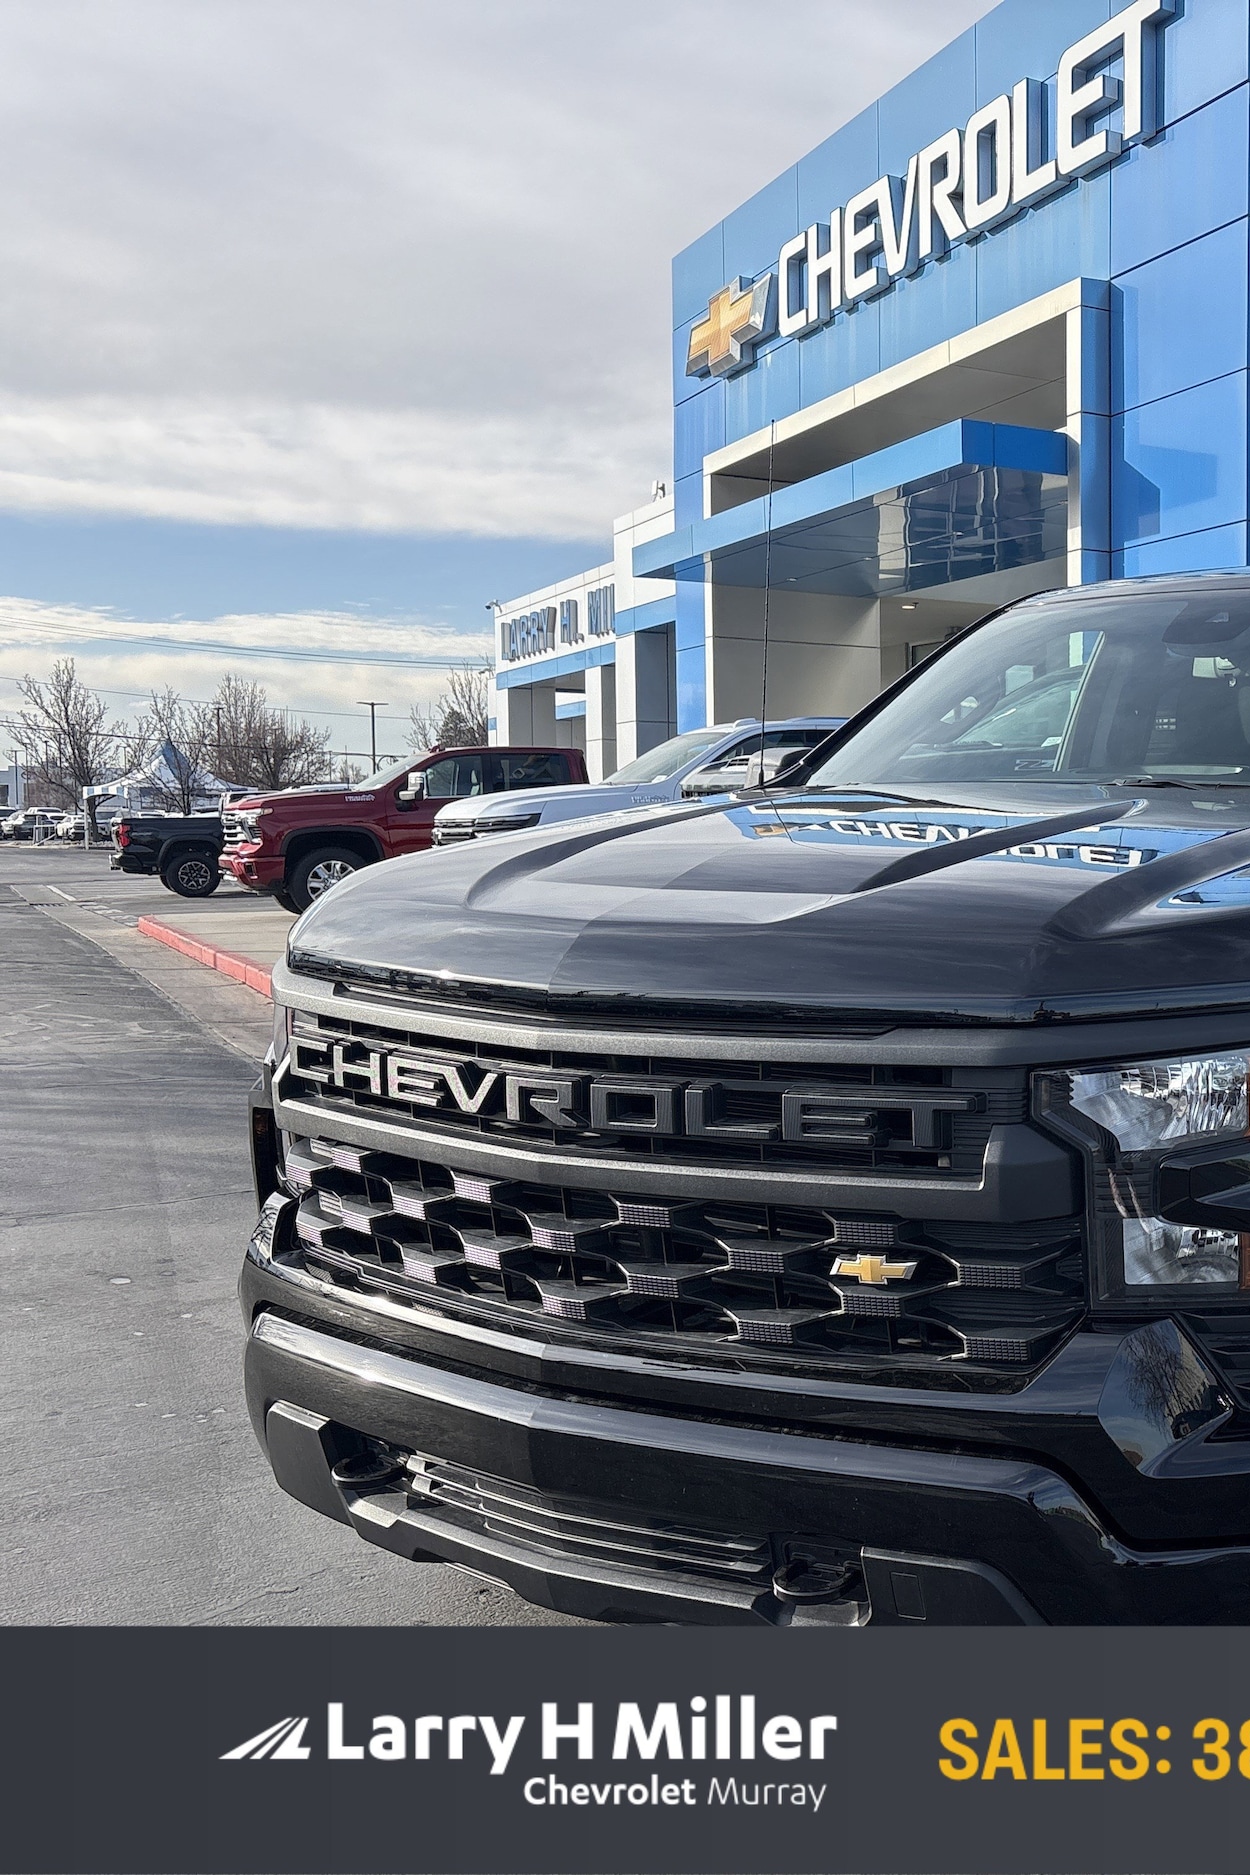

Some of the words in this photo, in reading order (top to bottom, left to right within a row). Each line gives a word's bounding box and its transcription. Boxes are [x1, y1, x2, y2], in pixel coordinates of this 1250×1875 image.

[778, 0, 1178, 340] CHEVROLET
[501, 606, 557, 661] LARRY
[289, 1034, 985, 1149] CHEVROLET
